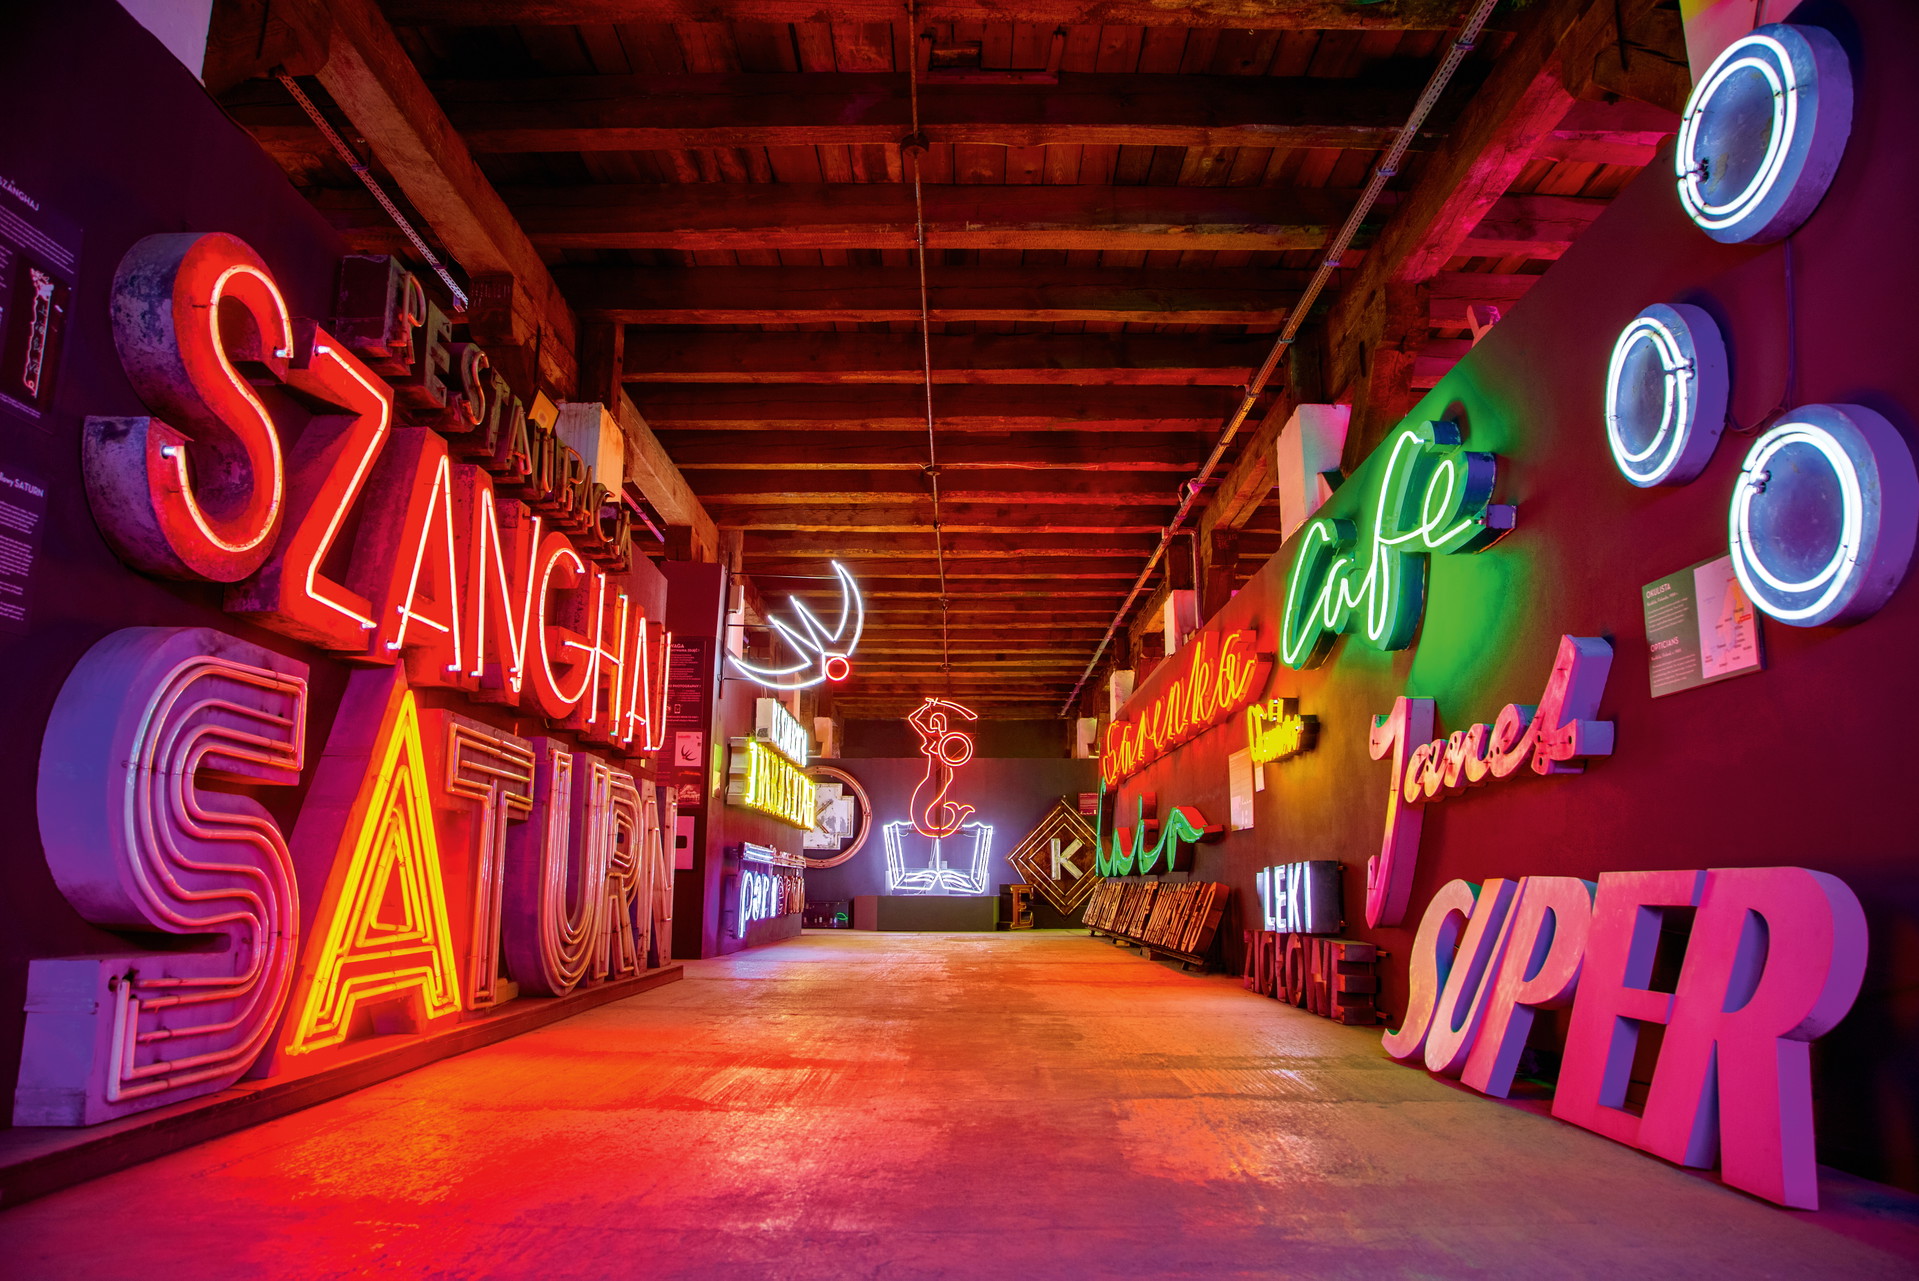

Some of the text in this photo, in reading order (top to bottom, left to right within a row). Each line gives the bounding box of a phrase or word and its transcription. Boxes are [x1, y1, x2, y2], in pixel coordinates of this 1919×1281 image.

[14, 478, 45, 498] SATURN
[90, 232, 673, 757] SZANGHAJ
[1645, 583, 1672, 599] OKULISTA
[1650, 636, 1680, 653] OPTICIANS
[30, 630, 677, 1124] SATURN
[1051, 838, 1084, 881] K
[1263, 860, 1312, 933] LEKI
[1382, 866, 1850, 1210] SUPER
